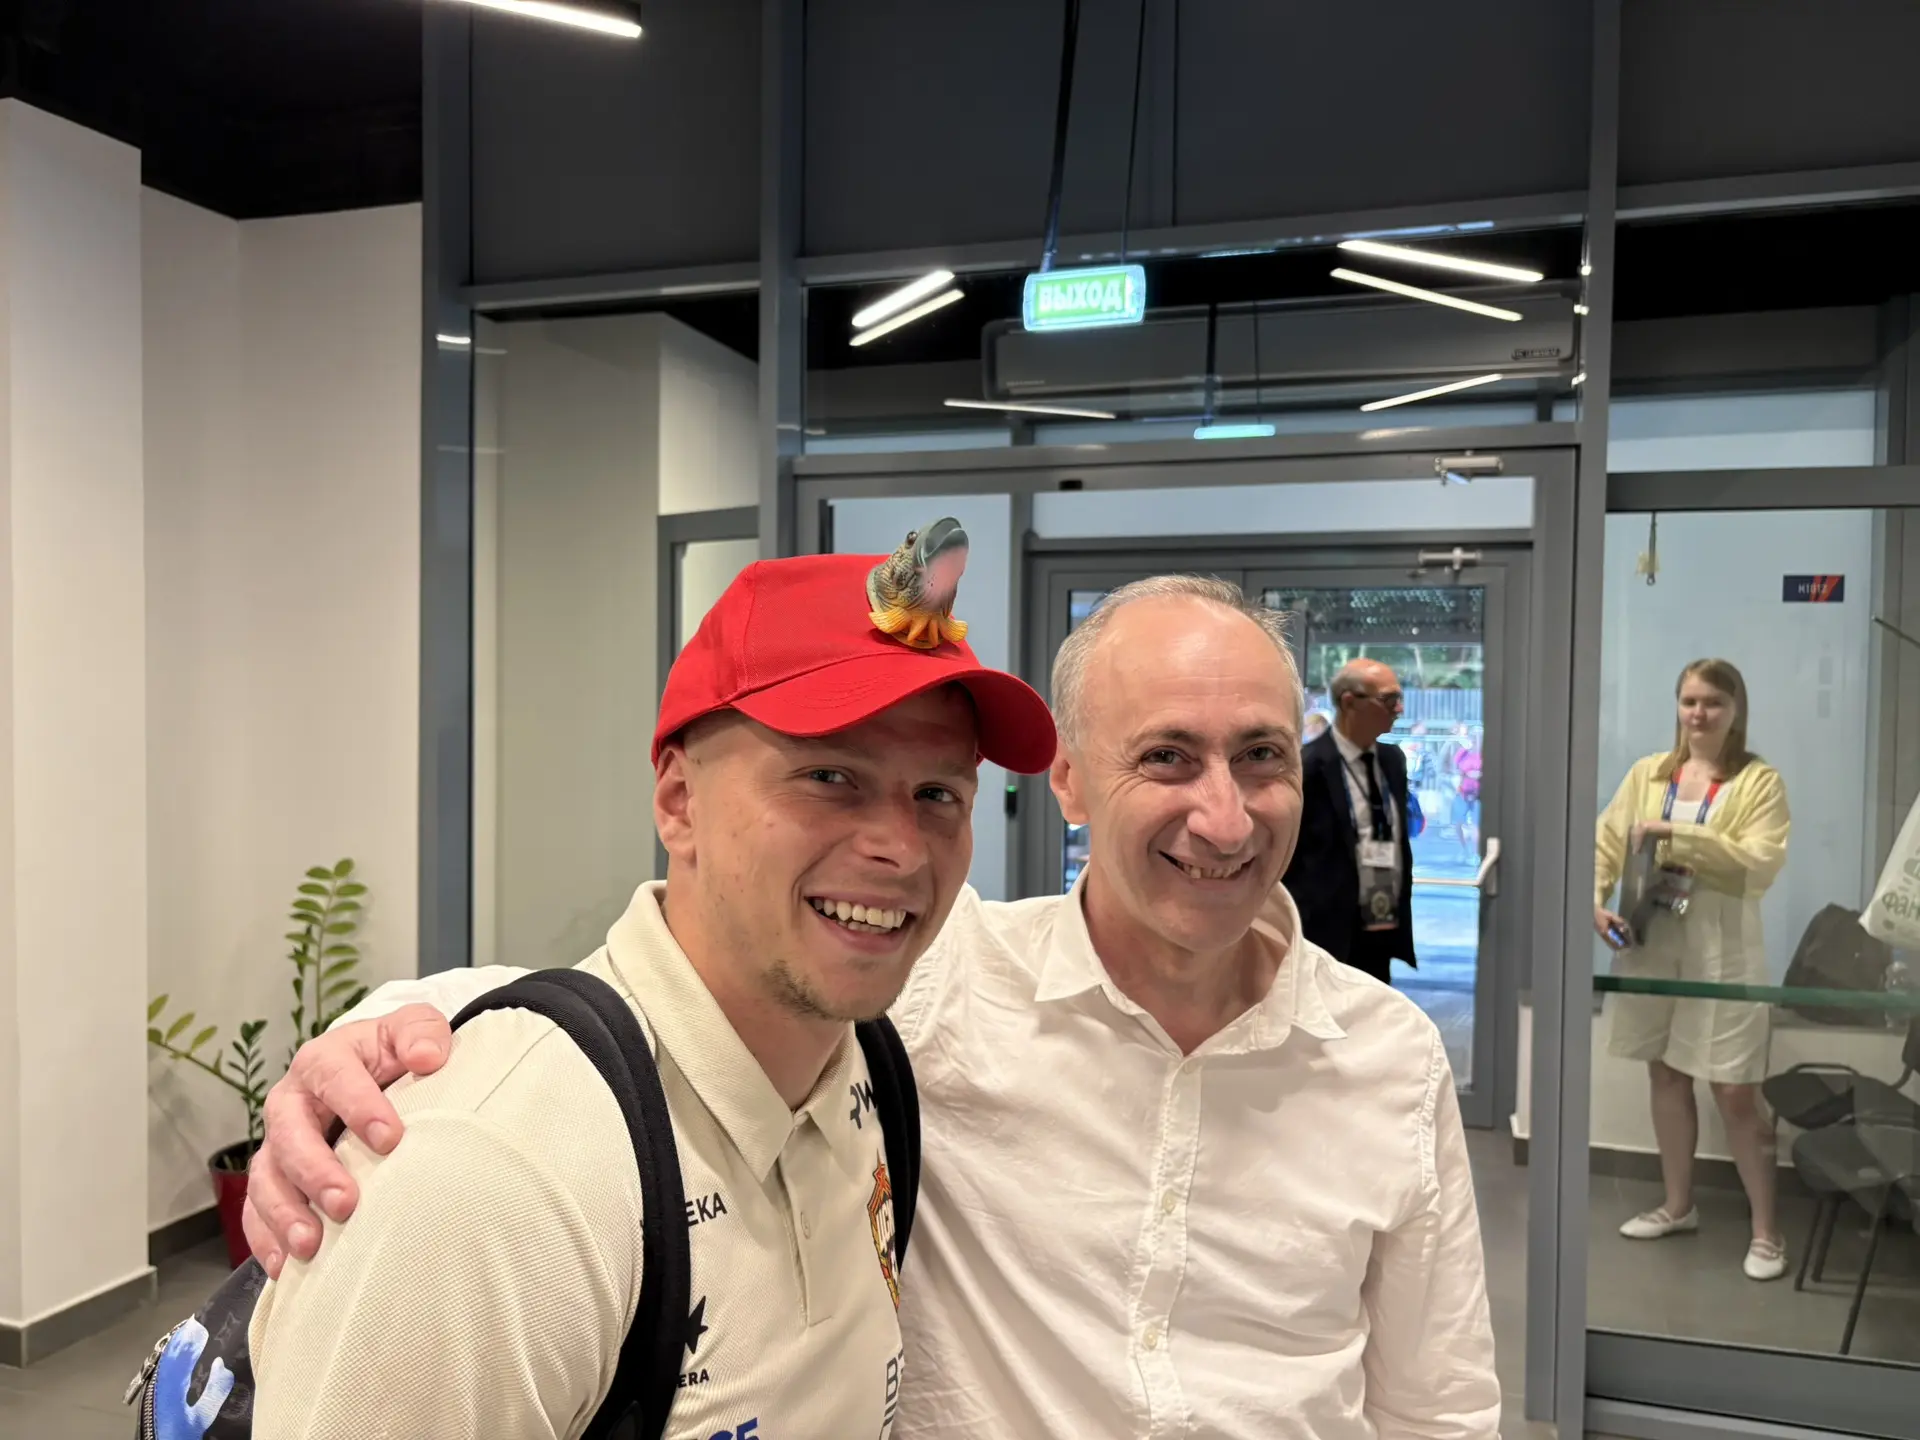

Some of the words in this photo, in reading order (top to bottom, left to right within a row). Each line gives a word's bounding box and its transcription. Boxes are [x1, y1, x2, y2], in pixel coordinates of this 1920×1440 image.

[1038, 280, 1121, 312] ВЫХОД
[685, 1192, 727, 1227] EKA
[677, 1369, 710, 1388] ERA
